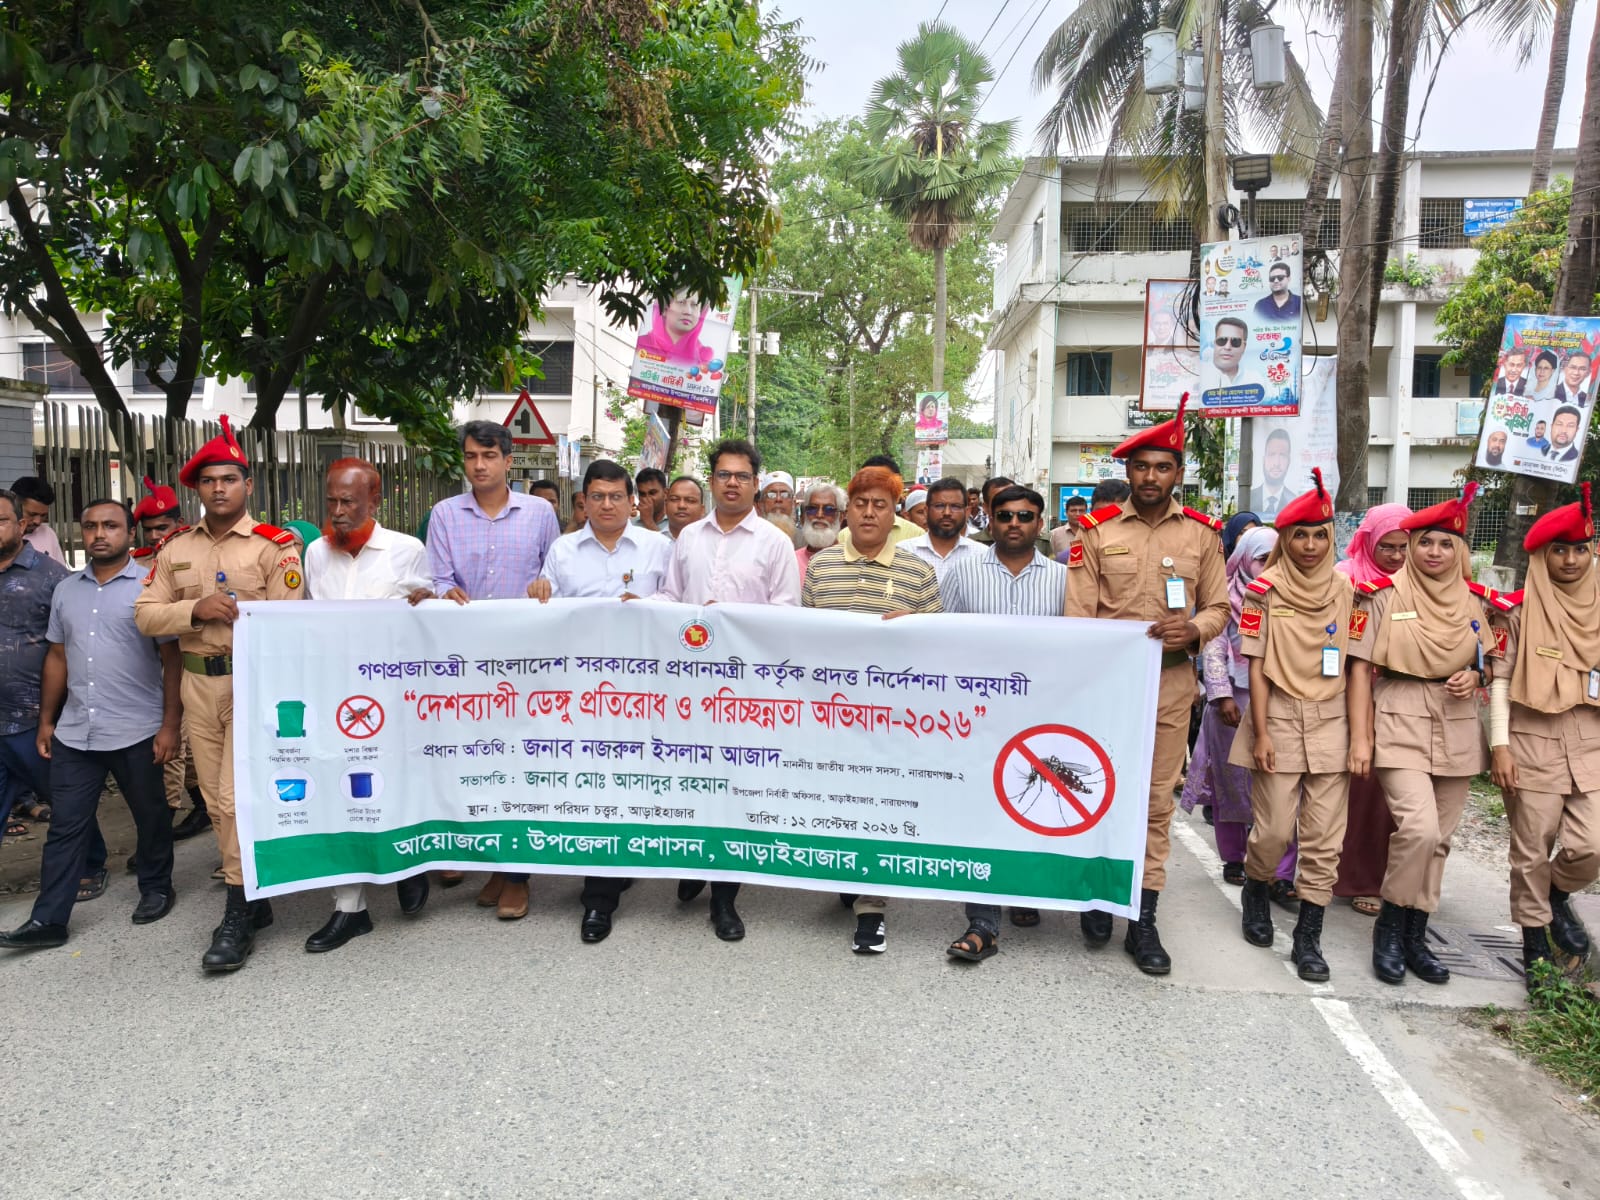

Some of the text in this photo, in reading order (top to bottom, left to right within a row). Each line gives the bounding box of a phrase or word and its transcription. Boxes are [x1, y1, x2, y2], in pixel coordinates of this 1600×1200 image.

[661, 375, 684, 388] বার্ষিকী
[358, 654, 1032, 699] গণপ্রজাতন্ত্রী বাংলাদেশ সরকারের প্রধানমন্ত্রী কর্তৃক প্রদত্ত নির্দেশনা অনুযায়ী
[527, 688, 575, 726] ডেঙ্গু
[579, 680, 669, 722] প্রতিরোধ
[674, 695, 693, 721] ও
[701, 686, 804, 733] পরিচ্ছন্নতা
[423, 744, 458, 760] প্রধান
[462, 738, 507, 757] অতিথি
[522, 738, 575, 760] জনাব
[580, 738, 645, 761] নজরুল
[652, 734, 714, 765] ইসলাম
[720, 745, 783, 769] আজাদ
[782, 758, 814, 771] মাননীয়
[816, 759, 845, 774] জাতীয়
[848, 763, 873, 775] সংসদ
[459, 770, 507, 788] সভাপতি
[524, 770, 568, 790] জনাব
[575, 771, 607, 791] মোঃ
[612, 771, 673, 797] আসাদুর
[678, 775, 730, 797] রহমান
[467, 803, 489, 817] স্থান
[502, 800, 550, 815] উপজেলা
[553, 801, 590, 817] পরিষদ
[627, 803, 696, 821] আড়াইহাজার
[746, 810, 780, 827] তারিখ
[790, 816, 807, 829] ১২
[811, 815, 858, 832] সেপ্টেম্বর
[862, 820, 899, 835] ২০২৬
[392, 830, 504, 857] আয়োজনে
[526, 827, 622, 856] উপজেলা
[877, 851, 992, 883] নারায়ণগঞ্জ
